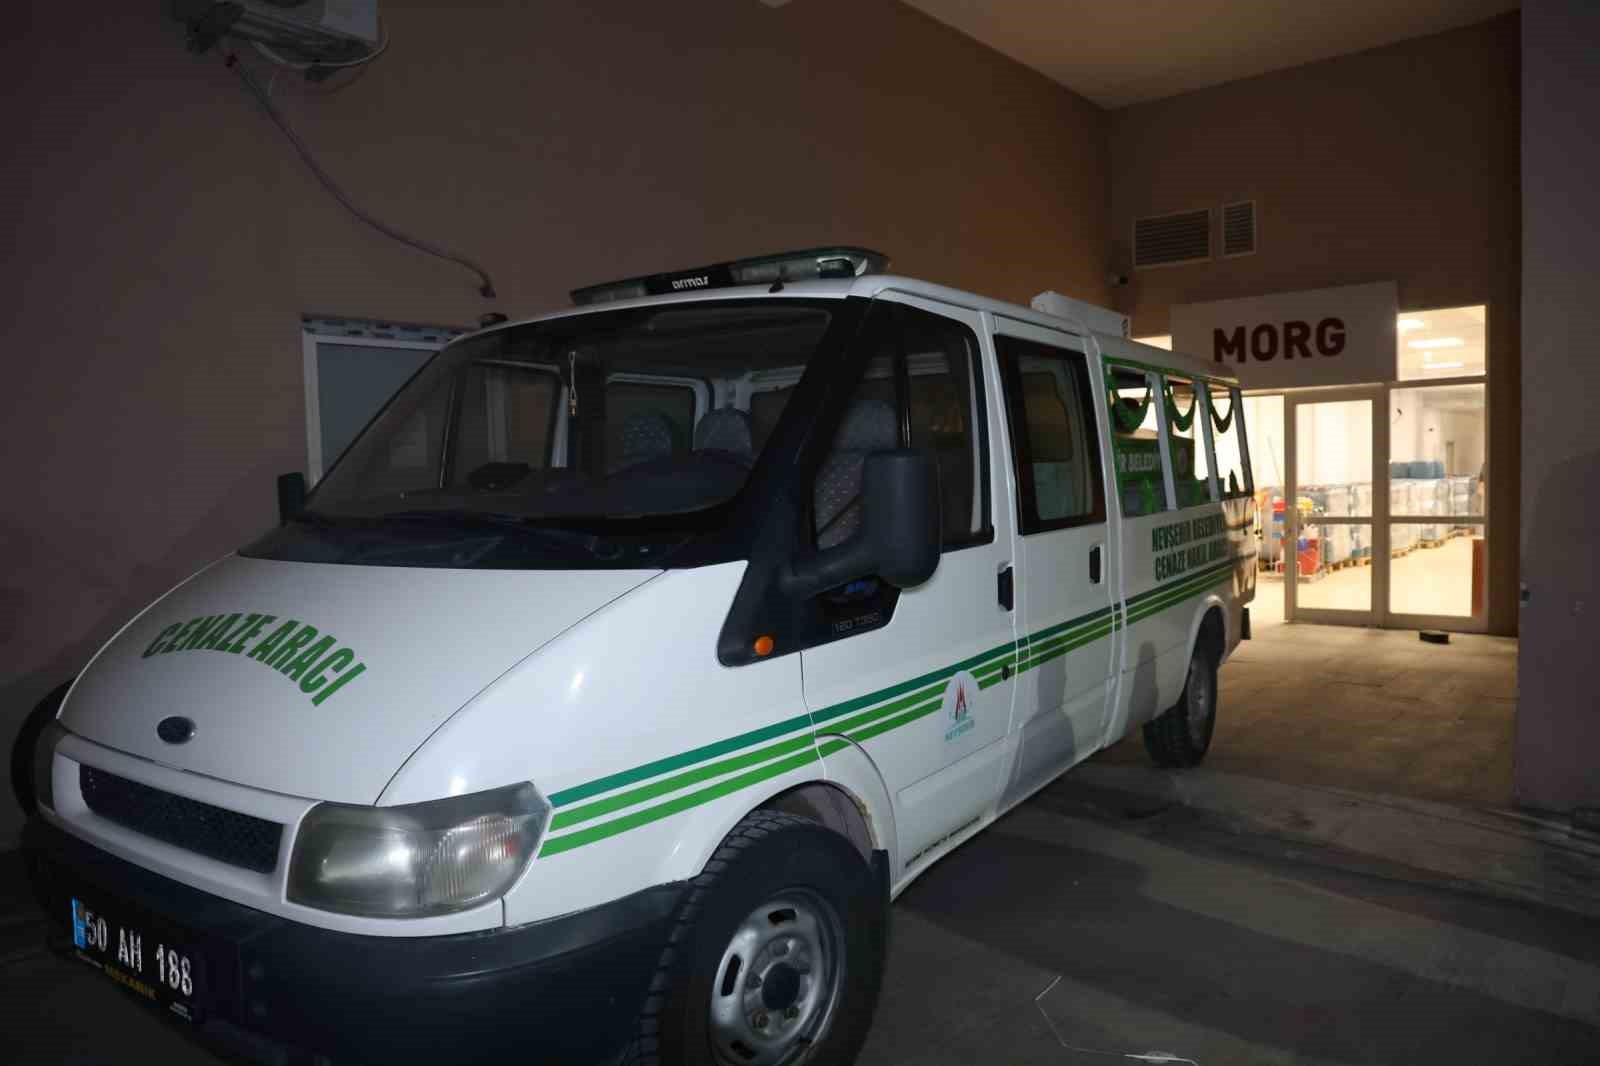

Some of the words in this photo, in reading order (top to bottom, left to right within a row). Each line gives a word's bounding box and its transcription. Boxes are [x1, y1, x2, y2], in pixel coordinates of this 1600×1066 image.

[1213, 317, 1346, 363] MORG
[1154, 550, 1186, 582] CENAZE
[141, 613, 278, 660] CENAZE
[246, 619, 368, 707] ARACI
[85, 911, 108, 952] 50
[118, 927, 142, 973] AH
[156, 943, 193, 996] 188
